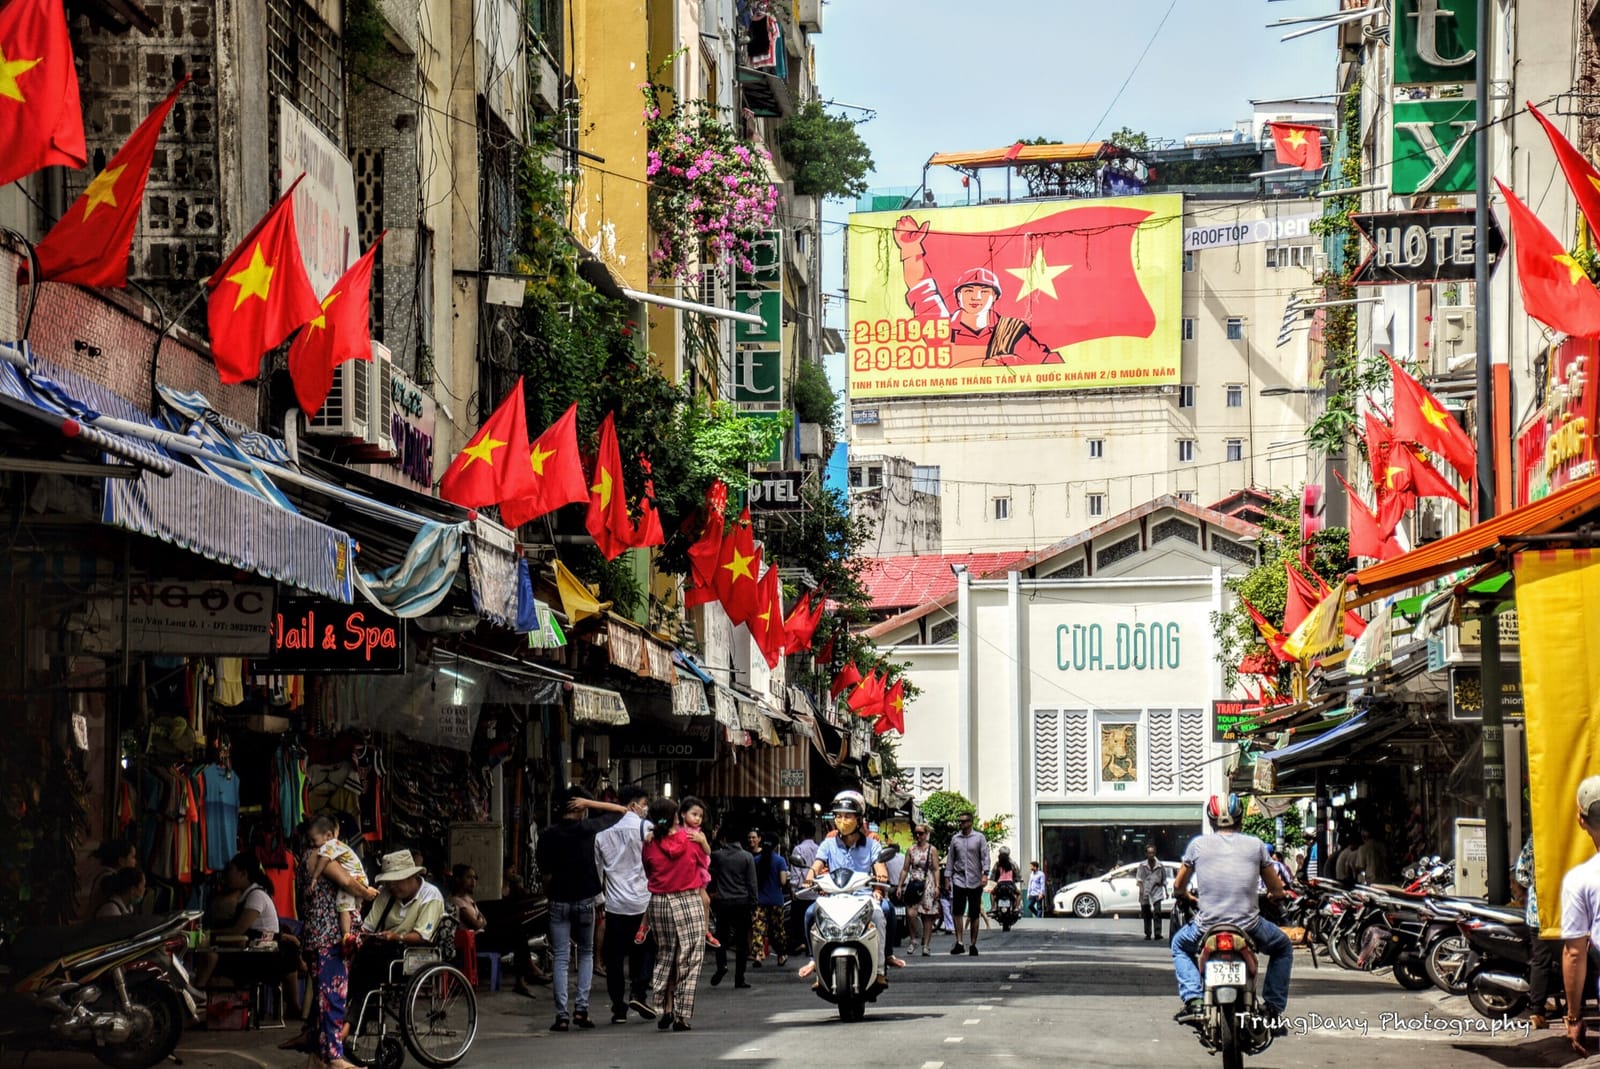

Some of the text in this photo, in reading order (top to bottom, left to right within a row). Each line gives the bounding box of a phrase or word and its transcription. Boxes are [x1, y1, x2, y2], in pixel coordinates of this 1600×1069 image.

[1192, 225, 1250, 246] ROOFTOP
[1377, 224, 1496, 268] HOTE
[852, 380, 872, 390] TINH
[903, 377, 927, 388] CÁCH
[930, 377, 957, 389] MẠNG
[962, 375, 992, 386] THÁNG
[1065, 369, 1097, 381] KHÁNH
[1100, 369, 1117, 379] 2/9
[750, 479, 799, 502] OTEL
[322, 624, 337, 650] &
[344, 611, 397, 661] Spa
[623, 743, 693, 756] ALAL FOOD
